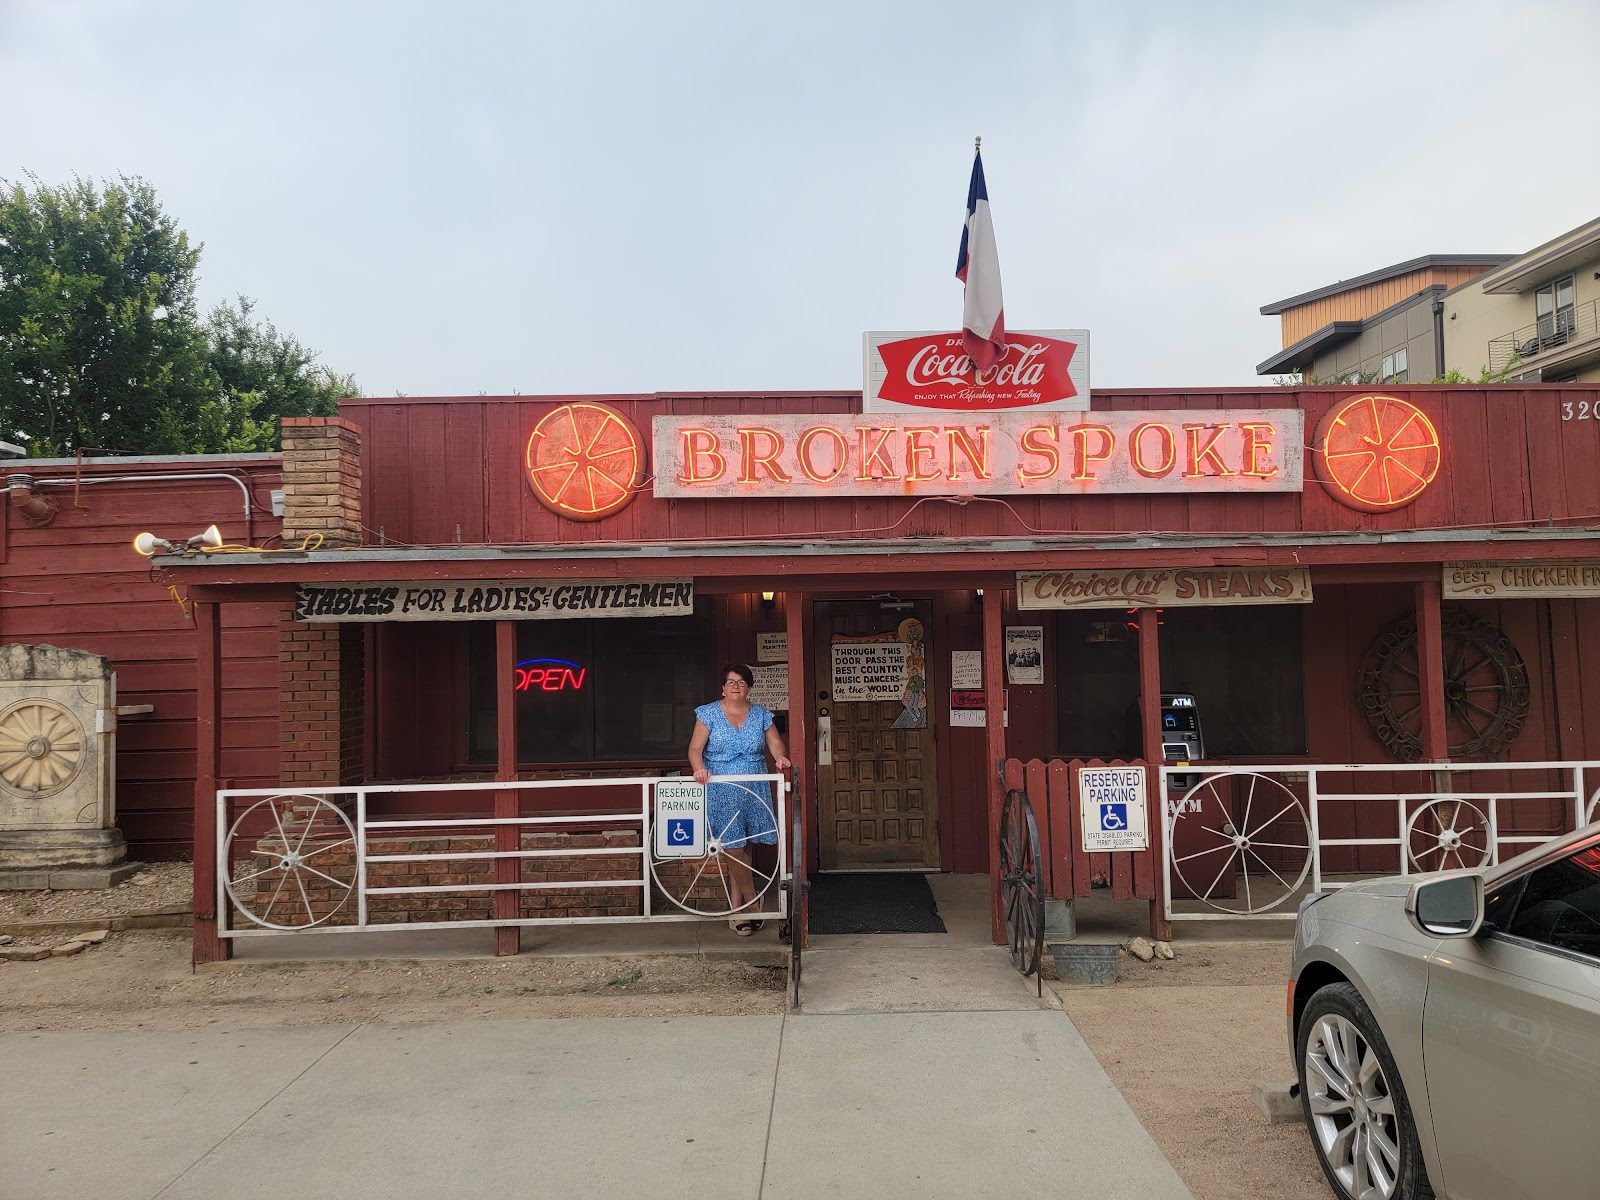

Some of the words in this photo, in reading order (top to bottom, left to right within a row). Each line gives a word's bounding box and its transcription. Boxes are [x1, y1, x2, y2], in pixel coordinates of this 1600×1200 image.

[906, 344, 971, 387] Coca
[957, 389, 996, 402] Refreshing
[1014, 389, 1041, 402] Feeling
[676, 426, 991, 484] BROKEN
[1018, 422, 1279, 481] SPOKE
[1452, 570, 1490, 584] BEST
[1501, 567, 1578, 587] CHICKEN
[1034, 571, 1118, 600] Choice
[1120, 570, 1169, 598] Cut
[302, 587, 400, 615] TABLES
[402, 588, 447, 613] FOR
[452, 587, 546, 613] LADIES
[552, 582, 693, 610] GENTLEMEN
[835, 657, 861, 665] DOOR
[866, 656, 887, 664] PASS
[835, 666, 856, 675] BEST
[860, 665, 904, 674] COUNTRY
[834, 676, 861, 684] MUSIC
[863, 675, 900, 684] DANCERS
[834, 685, 845, 694] in
[847, 685, 865, 694] the
[867, 685, 900, 693] WORLD
[1172, 698, 1192, 707] ATM
[1084, 772, 1140, 788] RESERVED
[659, 787, 702, 798] RESERVED
[1089, 788, 1136, 803] PARKING
[661, 801, 700, 811] PARKING
